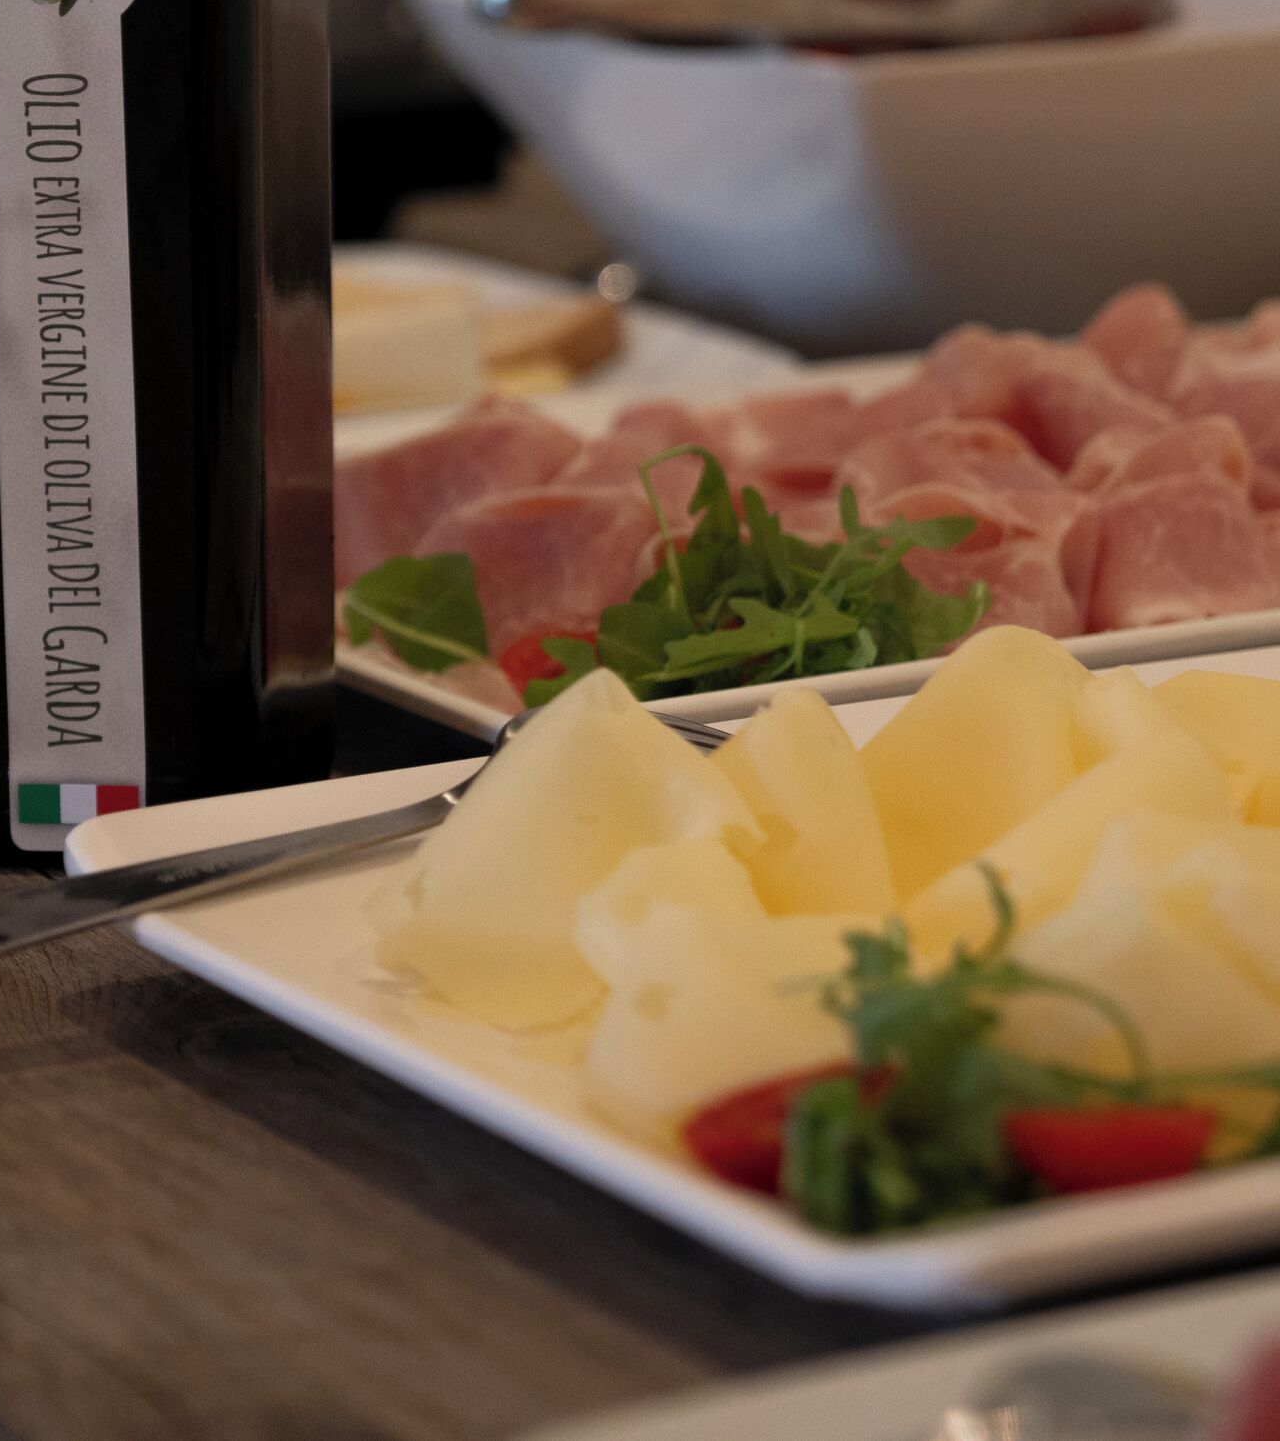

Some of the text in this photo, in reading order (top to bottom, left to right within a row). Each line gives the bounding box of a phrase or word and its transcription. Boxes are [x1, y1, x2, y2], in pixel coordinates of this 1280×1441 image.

[22, 73, 108, 747] OLIO EXTRA VERGINE DI OLIVA DEL GARDA
